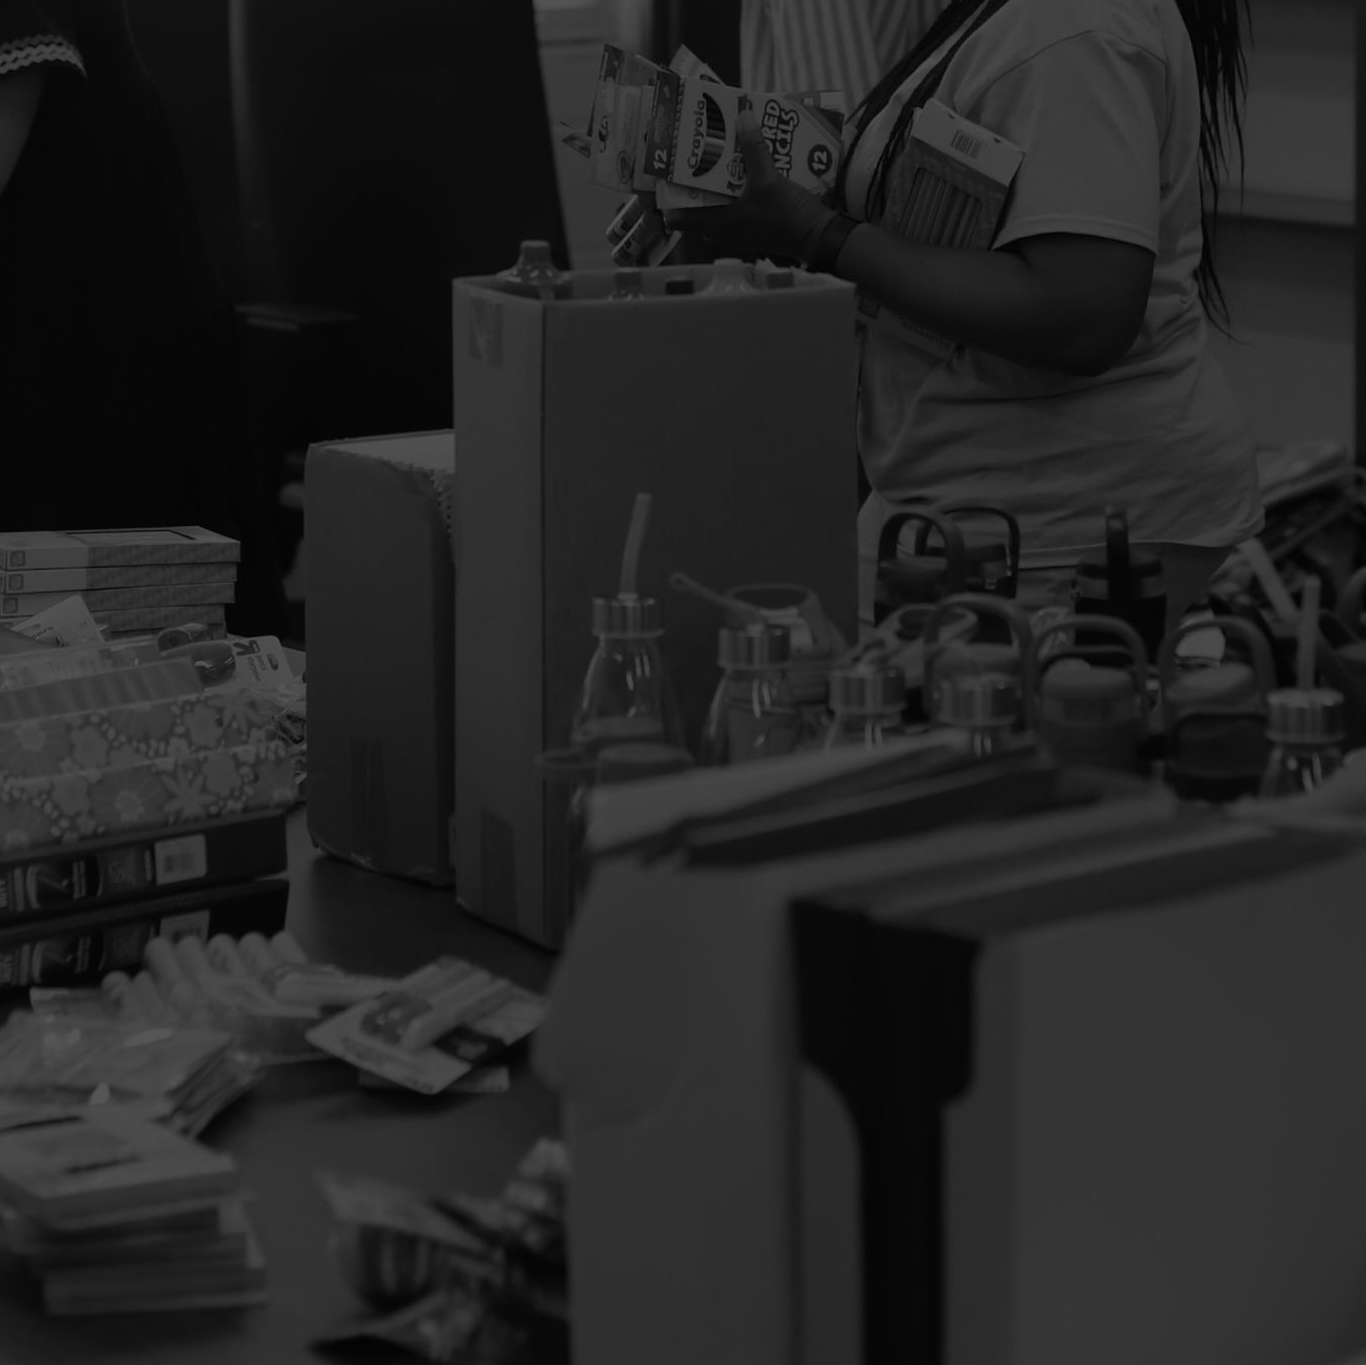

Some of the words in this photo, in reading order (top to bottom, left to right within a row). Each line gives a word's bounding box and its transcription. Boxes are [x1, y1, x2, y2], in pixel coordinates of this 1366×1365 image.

[687, 99, 707, 169] Crayola
[653, 148, 667, 171] 12
[811, 149, 828, 171] 12
